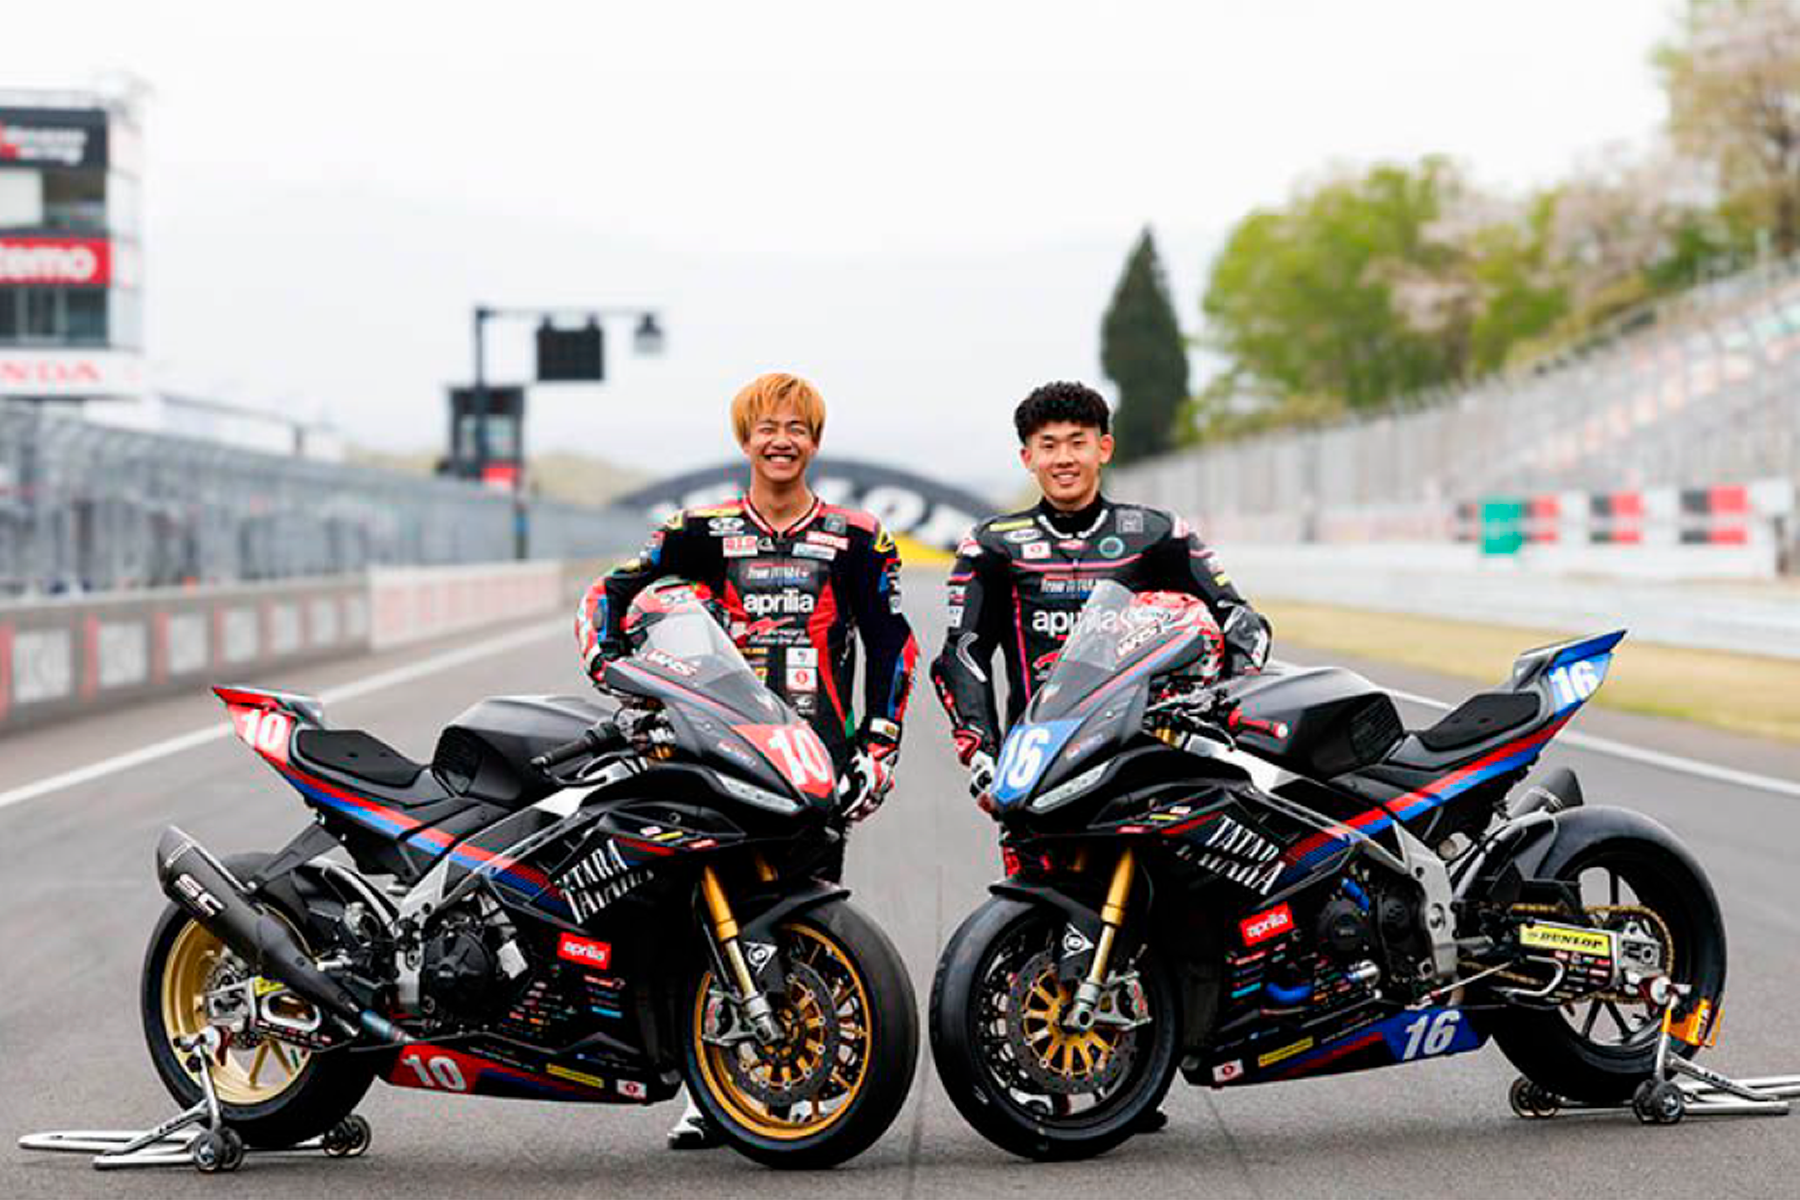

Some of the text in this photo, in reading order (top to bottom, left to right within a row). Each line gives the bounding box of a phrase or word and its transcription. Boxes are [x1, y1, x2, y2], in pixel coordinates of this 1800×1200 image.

[743, 588, 814, 616] aprilia
[1547, 660, 1600, 704] 16
[240, 708, 287, 751] 10
[769, 728, 832, 786] 10
[1000, 727, 1050, 788] 16
[1246, 913, 1289, 939] aprilia
[1540, 931, 1604, 950] DUNLOP
[563, 941, 606, 961] aprilia
[1402, 1010, 1462, 1061] 16
[402, 1054, 467, 1091] 10
